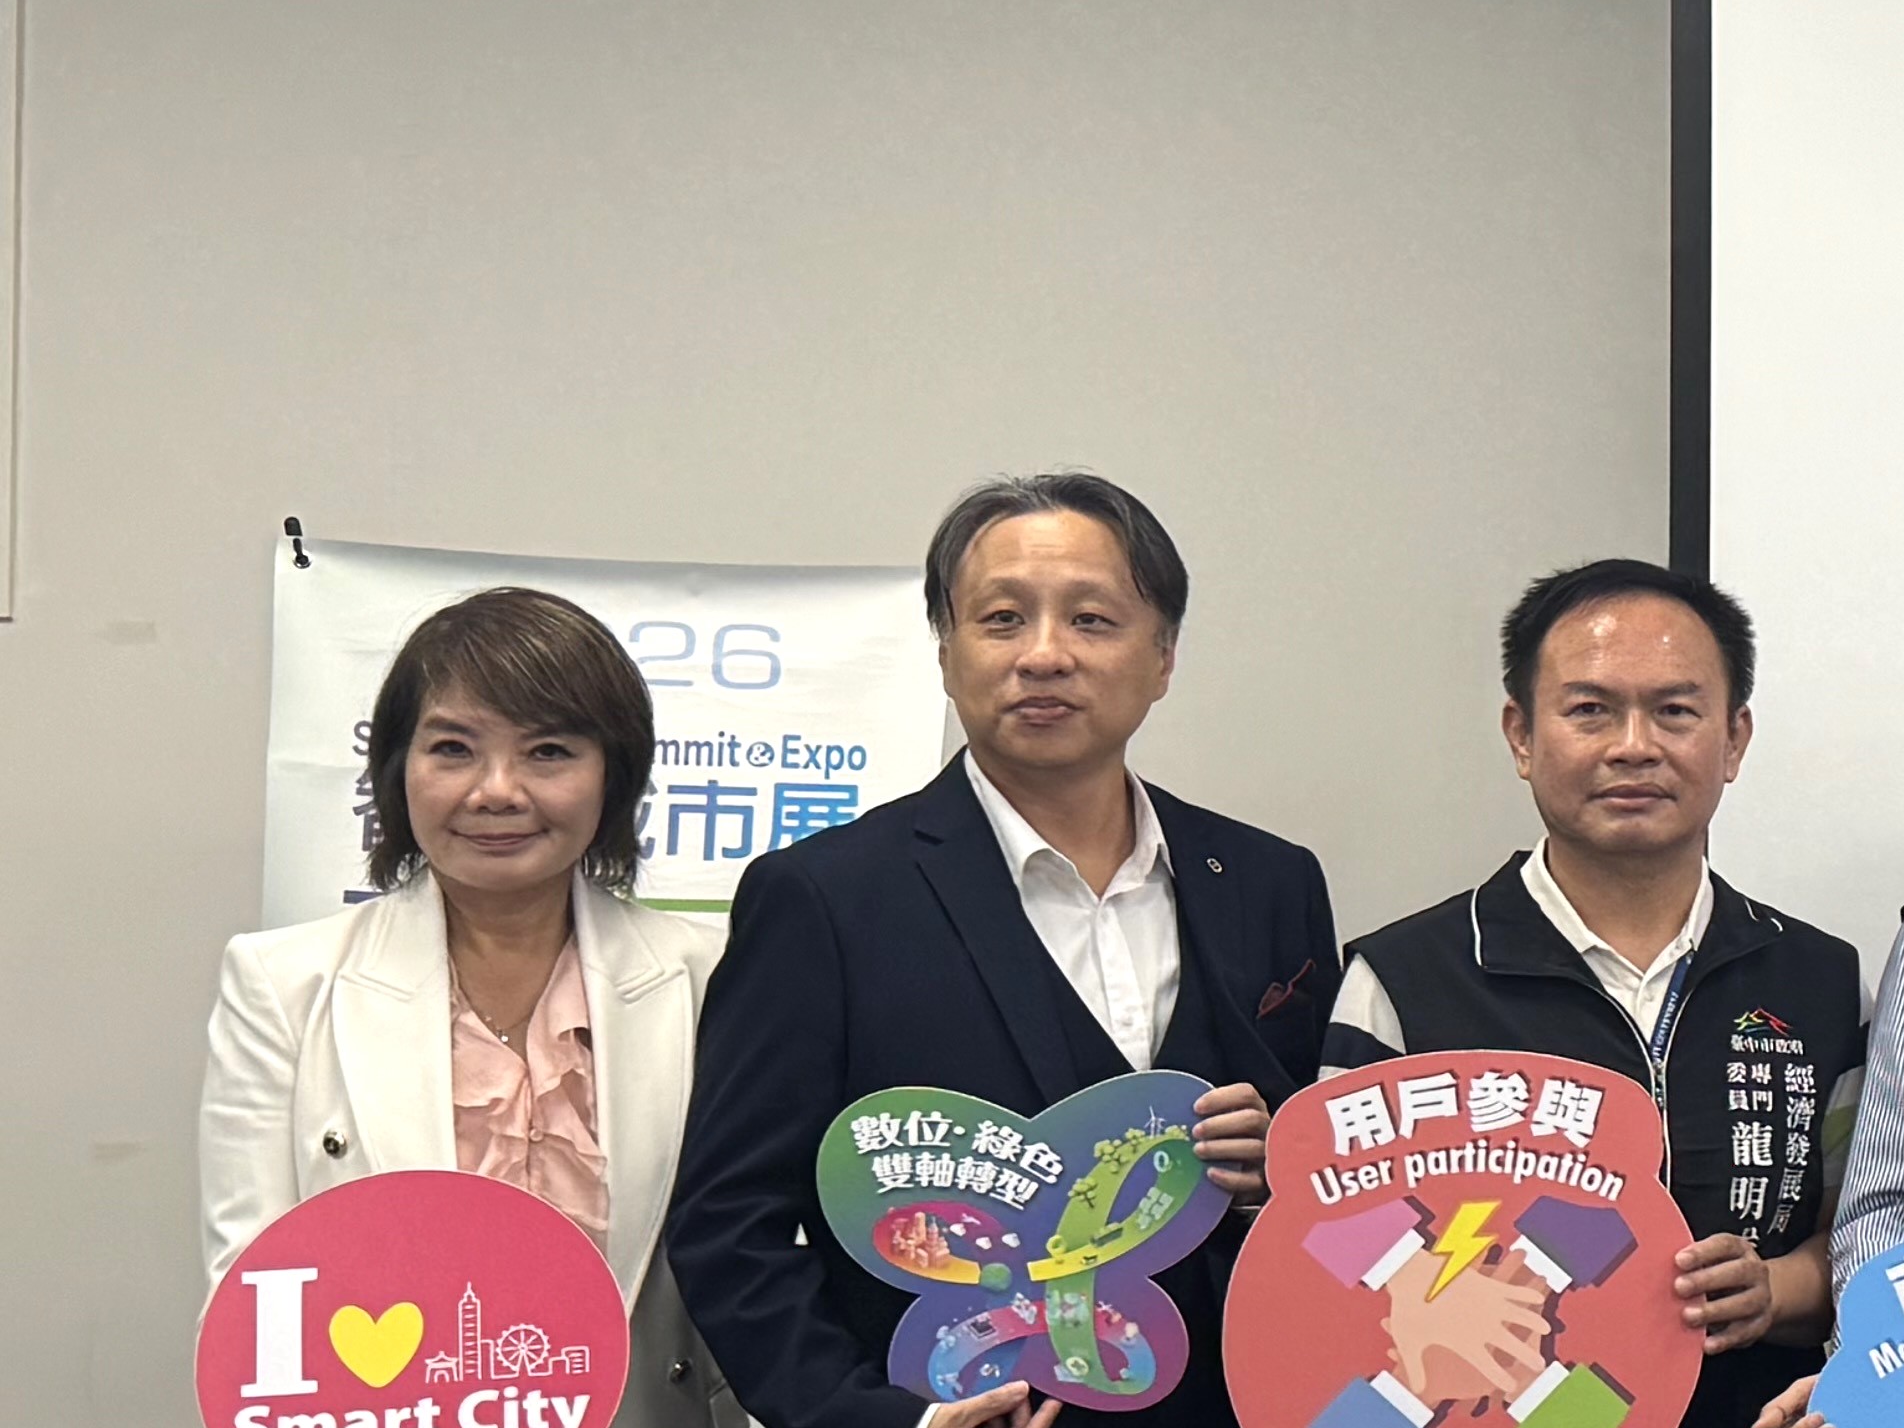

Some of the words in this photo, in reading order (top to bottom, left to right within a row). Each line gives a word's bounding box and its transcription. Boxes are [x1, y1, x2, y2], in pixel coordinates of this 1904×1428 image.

[629, 621, 781, 690] 26
[655, 731, 742, 767] mmit
[781, 734, 867, 780] Expo
[1325, 1070, 1605, 1157] 用戶參與
[871, 1151, 1039, 1211] 雙軸轉型
[1309, 1156, 1395, 1205] User
[1404, 1140, 1624, 1201] participation
[1767, 1063, 1817, 1235] 經濟發展局
[239, 1267, 318, 1398] I
